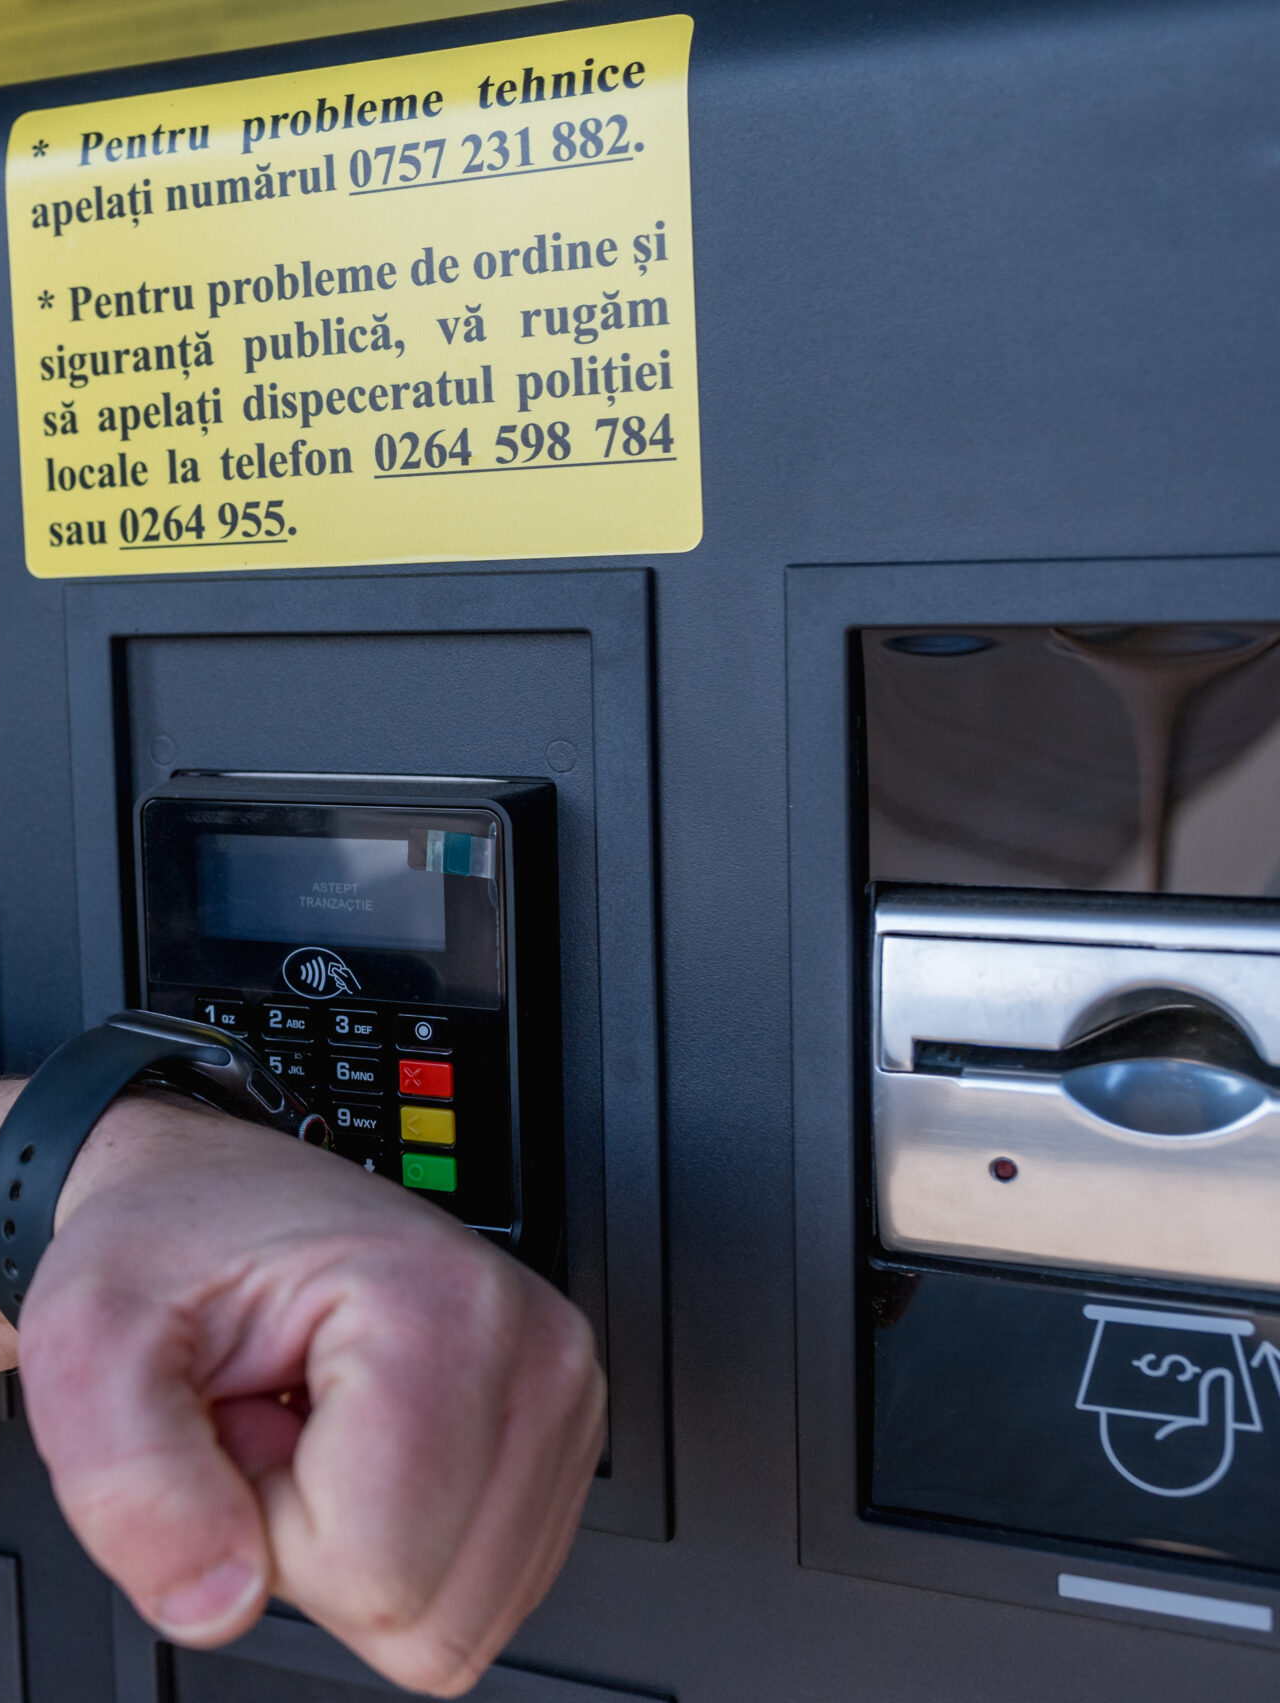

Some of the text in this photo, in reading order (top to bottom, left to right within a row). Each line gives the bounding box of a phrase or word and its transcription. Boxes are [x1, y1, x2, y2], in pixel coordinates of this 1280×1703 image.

[79, 123, 210, 167] Pentru
[240, 90, 446, 154] probleme
[476, 57, 646, 110] tehnice
[31, 113, 645, 238] apelați numărul 0757 231 882.
[67, 280, 196, 323] Pentru
[206, 260, 397, 323] probleme
[410, 246, 460, 287] de
[473, 231, 619, 280] ordine
[632, 220, 669, 277] și
[242, 312, 406, 375] publică,
[435, 303, 488, 346] vă
[519, 289, 671, 345] rugăm
[42, 348, 674, 442] să apelați dispeceratul poliției
[45, 412, 675, 493] locale la telefon 0264 598 784
[48, 499, 298, 548] sau 0264 955.
[204, 1004, 236, 1025] 1 QZ
[269, 1009, 305, 1029] 2 ABC
[335, 1015, 373, 1035] 3 DEF
[269, 1056, 305, 1076] 5 JKL
[336, 1061, 374, 1082] 6 MNO
[337, 1108, 377, 1129] 9 WXY
